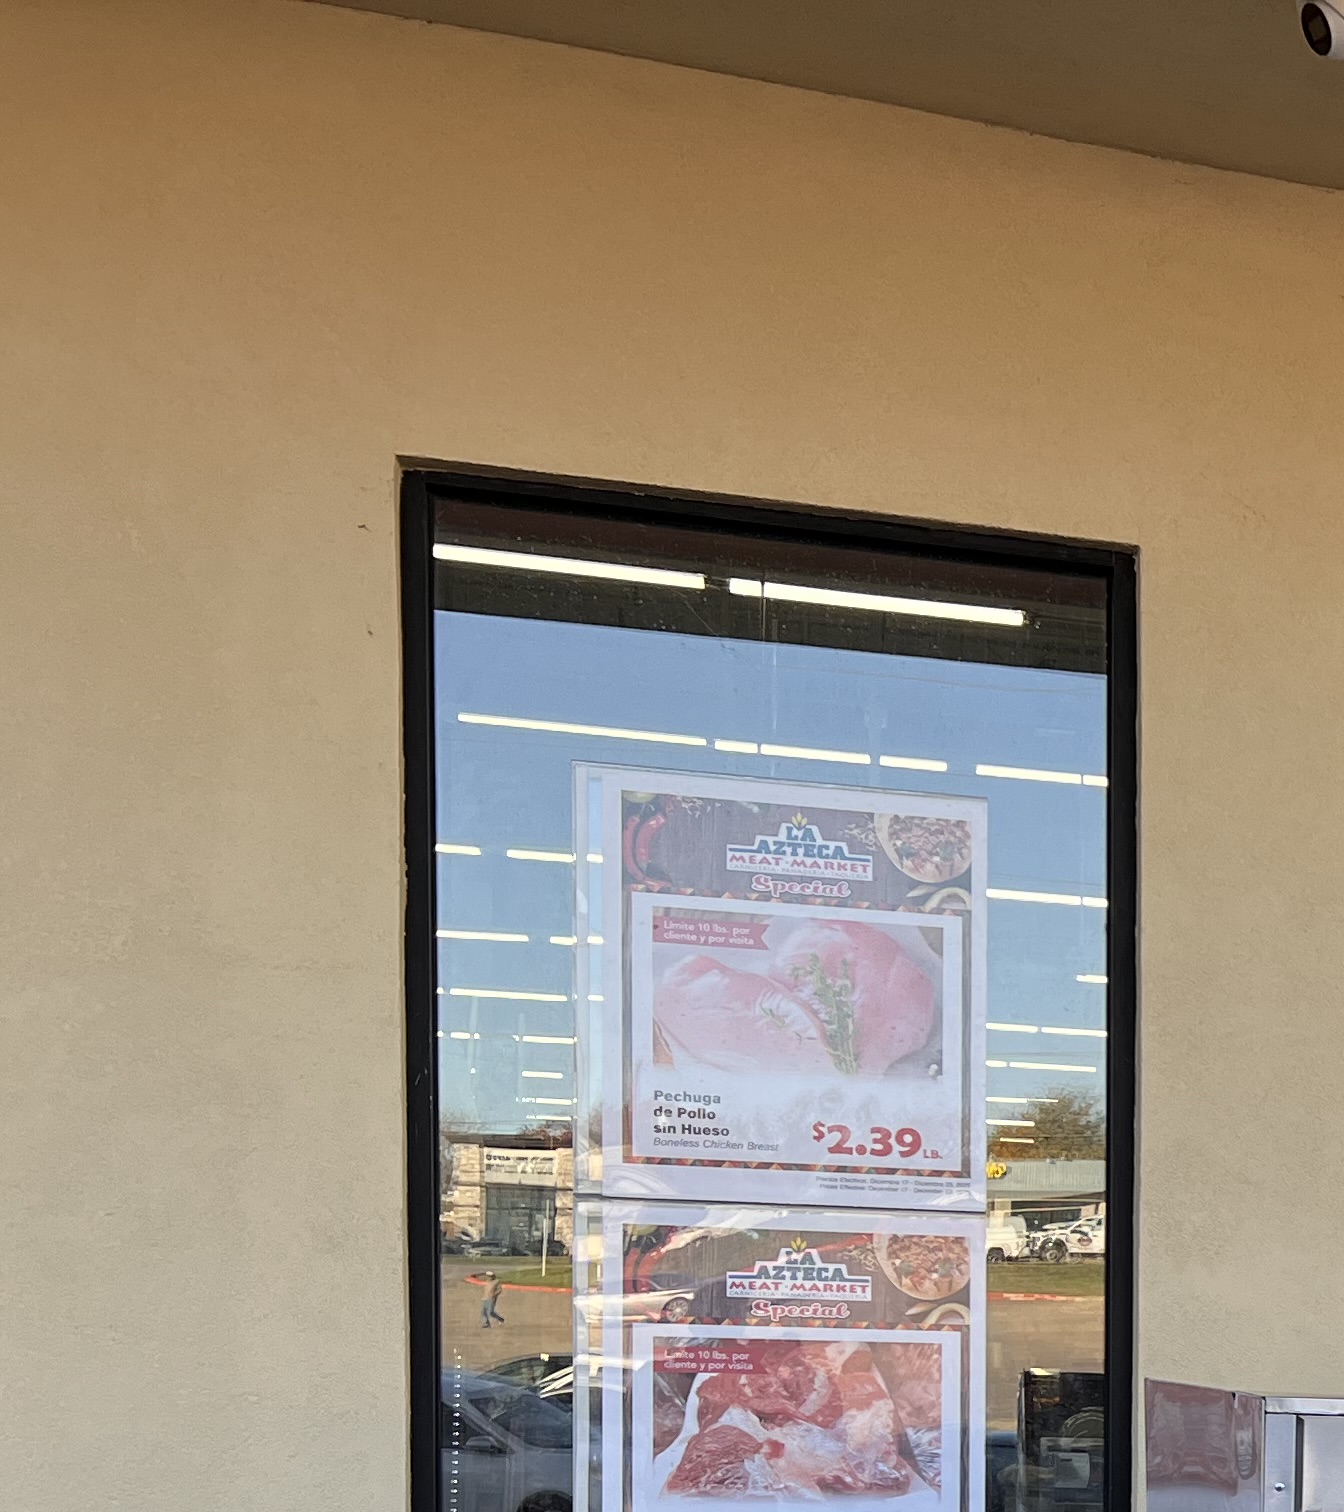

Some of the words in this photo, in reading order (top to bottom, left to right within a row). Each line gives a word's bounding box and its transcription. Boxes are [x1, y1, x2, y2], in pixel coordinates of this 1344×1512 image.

[786, 825, 816, 843] LA
[756, 839, 848, 860] AZTECA
[729, 854, 783, 867] MEAT
[791, 859, 871, 874] MARKET
[751, 874, 851, 897] Special
[698, 922, 710, 932] 10
[733, 927, 750, 937] por
[664, 931, 697, 941] cliente
[708, 936, 725, 944] por
[729, 936, 754, 945] visita
[653, 1090, 721, 1105] Pechuga
[653, 1106, 673, 1118] de
[677, 1107, 716, 1120] Pollo
[653, 1123, 676, 1135] sin
[681, 1124, 730, 1137] Hueso
[653, 1137, 700, 1148] Boneless
[703, 1139, 744, 1150] Chicken
[747, 1142, 779, 1152] Breast
[812, 1120, 923, 1158] $2.39
[785, 1250, 816, 1266] LA
[756, 1265, 847, 1282] AZTECA
[729, 1281, 783, 1290] MEAT
[790, 1283, 869, 1293] MARKET
[751, 1300, 850, 1321] Special
[698, 1351, 710, 1359] 10
[712, 1351, 729, 1360] lbs.
[732, 1353, 750, 1362] por
[664, 1361, 697, 1369] cliente
[708, 1363, 725, 1371] por
[728, 1362, 754, 1370] visita
